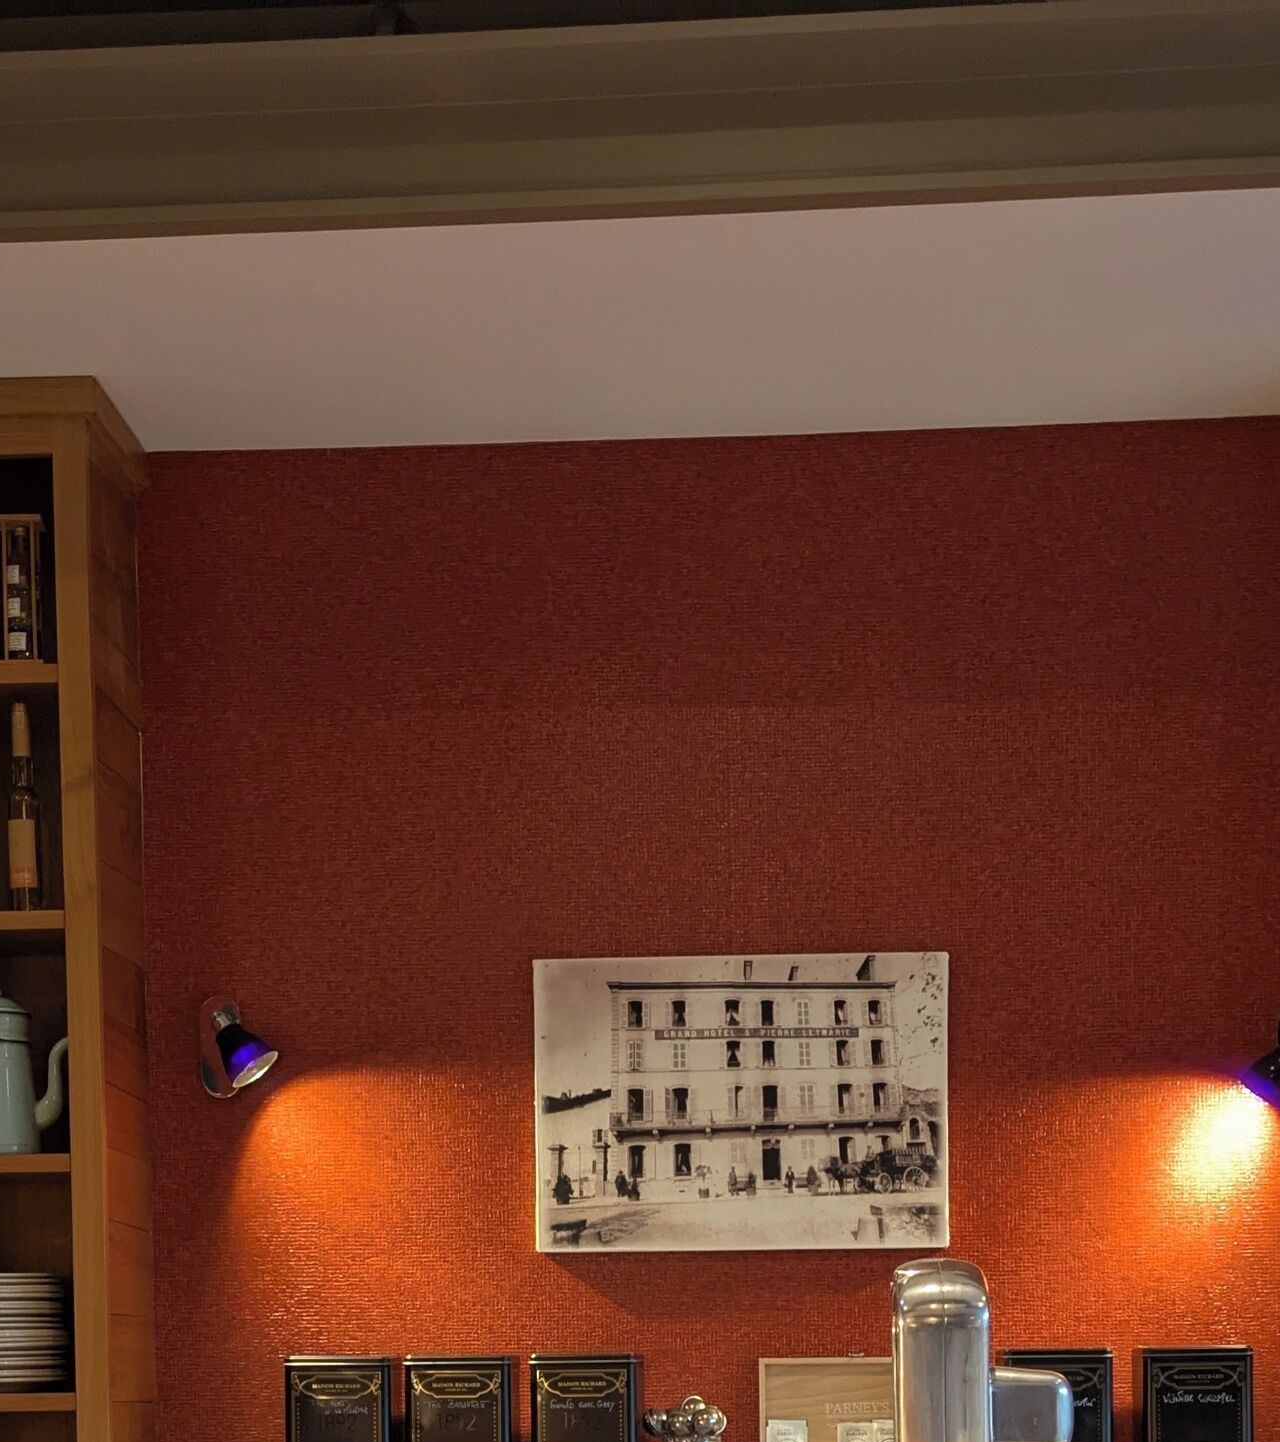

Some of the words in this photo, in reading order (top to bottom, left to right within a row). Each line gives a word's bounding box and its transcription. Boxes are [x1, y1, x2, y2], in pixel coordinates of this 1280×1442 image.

[663, 1030, 697, 1038] GRAND
[704, 1029, 736, 1037] HOTEL
[824, 1401, 890, 1414] PARNEY'S
